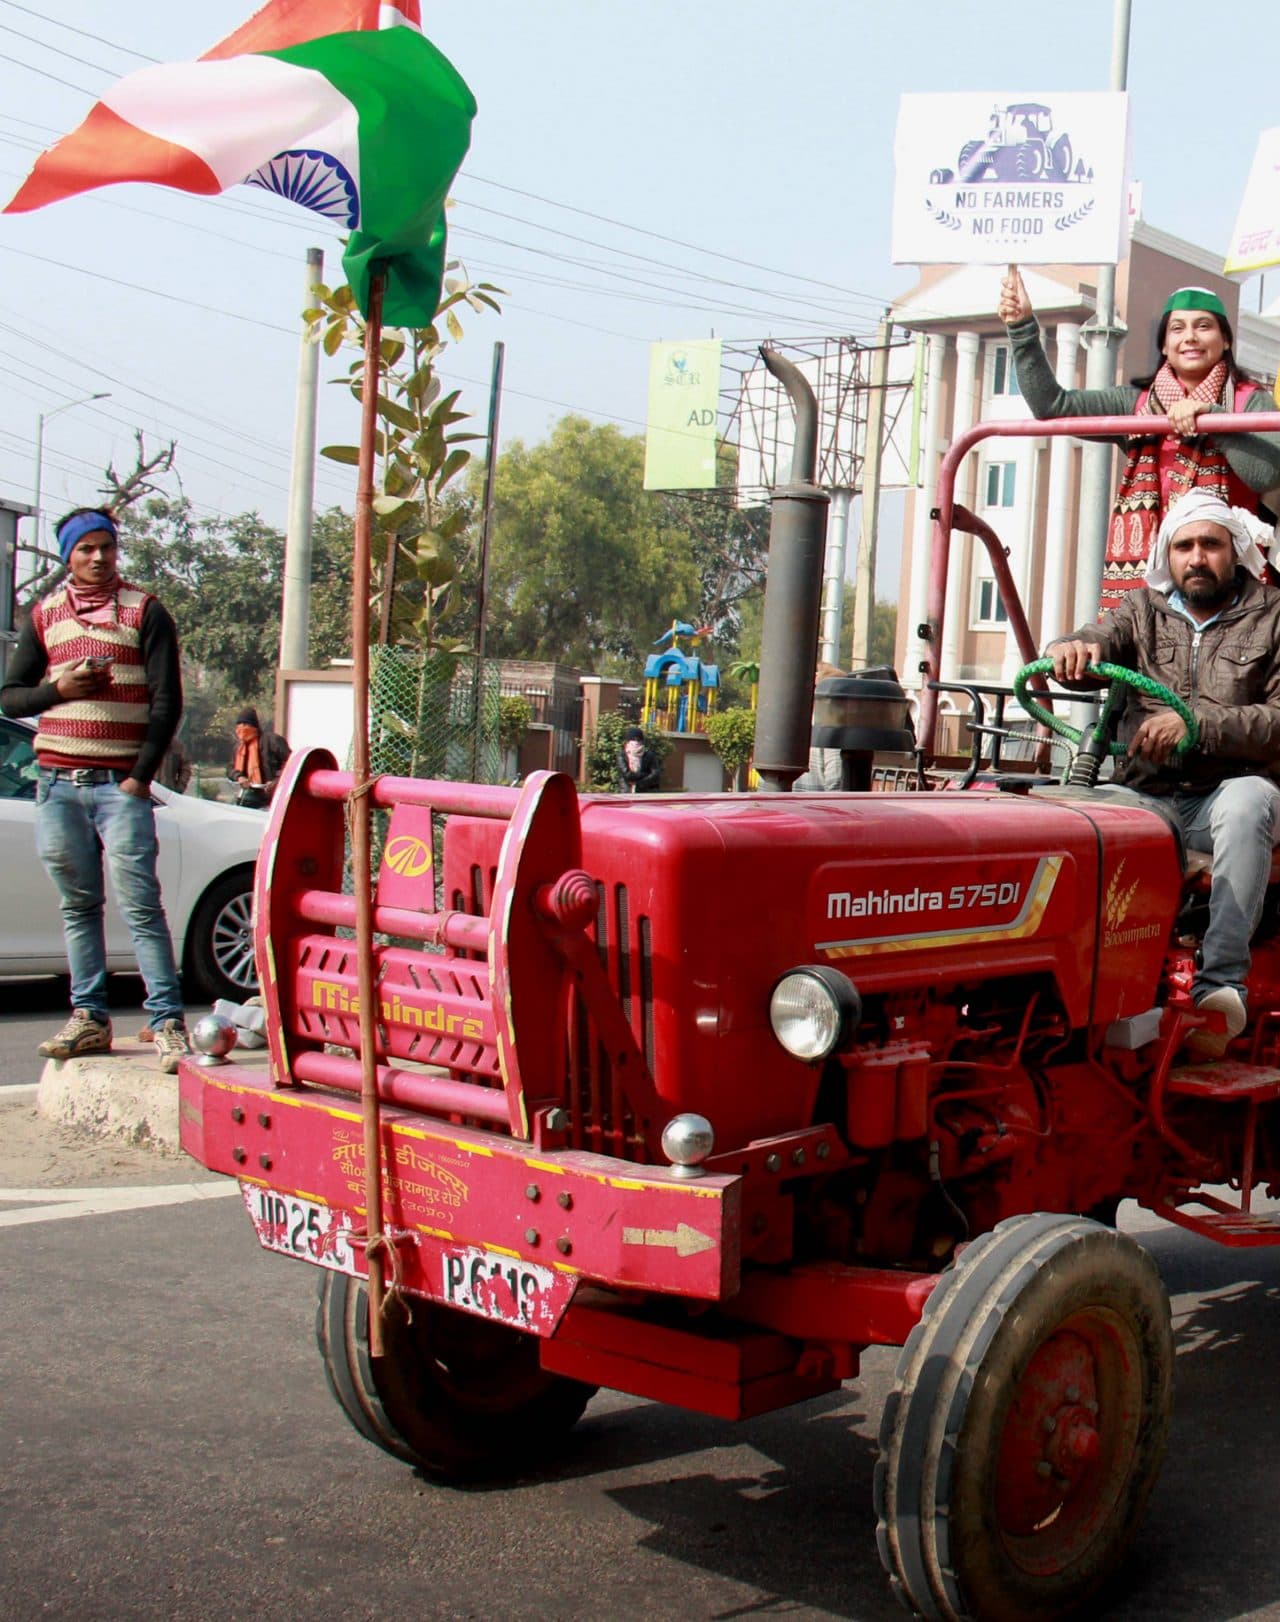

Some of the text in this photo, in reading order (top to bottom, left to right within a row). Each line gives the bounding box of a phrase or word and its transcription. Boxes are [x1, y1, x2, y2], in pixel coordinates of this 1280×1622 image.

[955, 191, 1065, 209] NO FARMERS
[972, 217, 1044, 235] NO FOOD
[686, 409, 718, 427] AD
[827, 887, 943, 919] Mahindra
